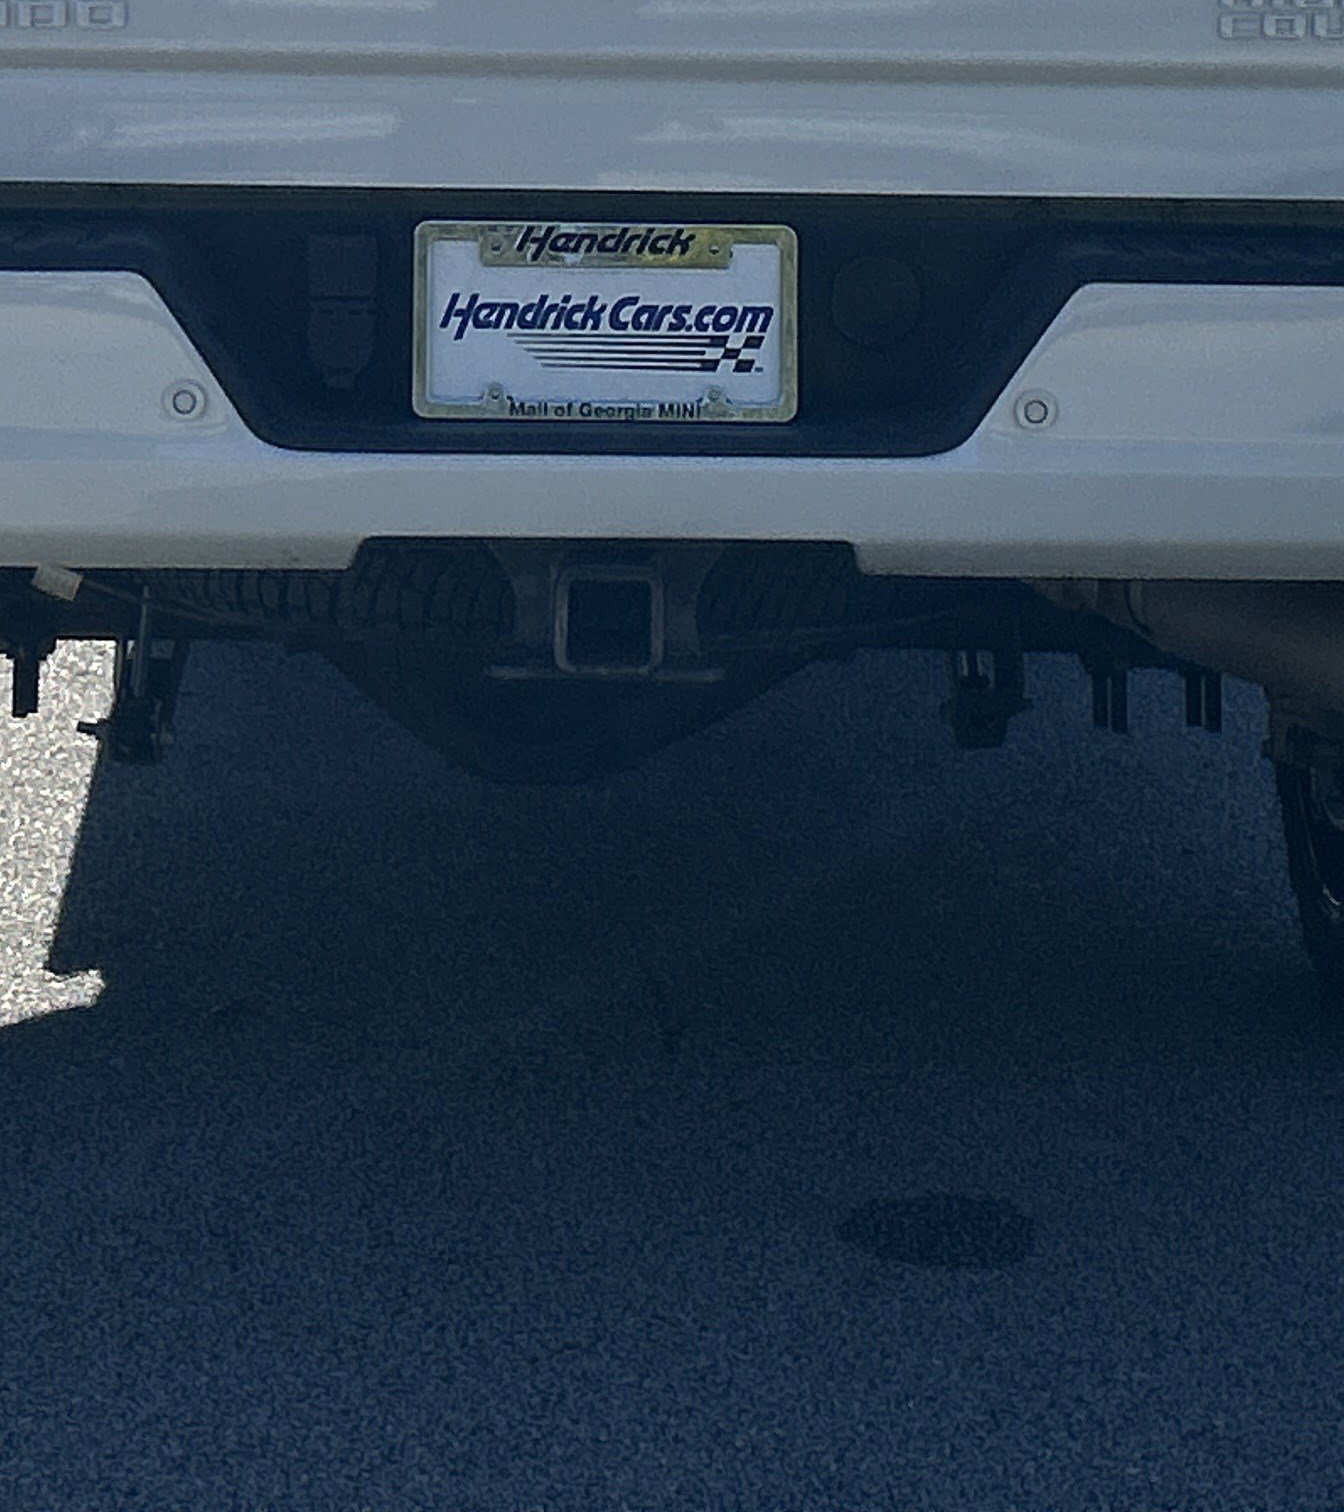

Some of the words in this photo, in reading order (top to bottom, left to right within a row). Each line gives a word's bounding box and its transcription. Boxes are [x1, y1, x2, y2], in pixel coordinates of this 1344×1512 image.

[516, 225, 696, 262] Hendrick
[439, 292, 774, 341] HendrickCars.com
[509, 402, 548, 417] Mall
[553, 402, 573, 418] of
[579, 402, 653, 421] Georgia
[658, 403, 702, 420] MINI
